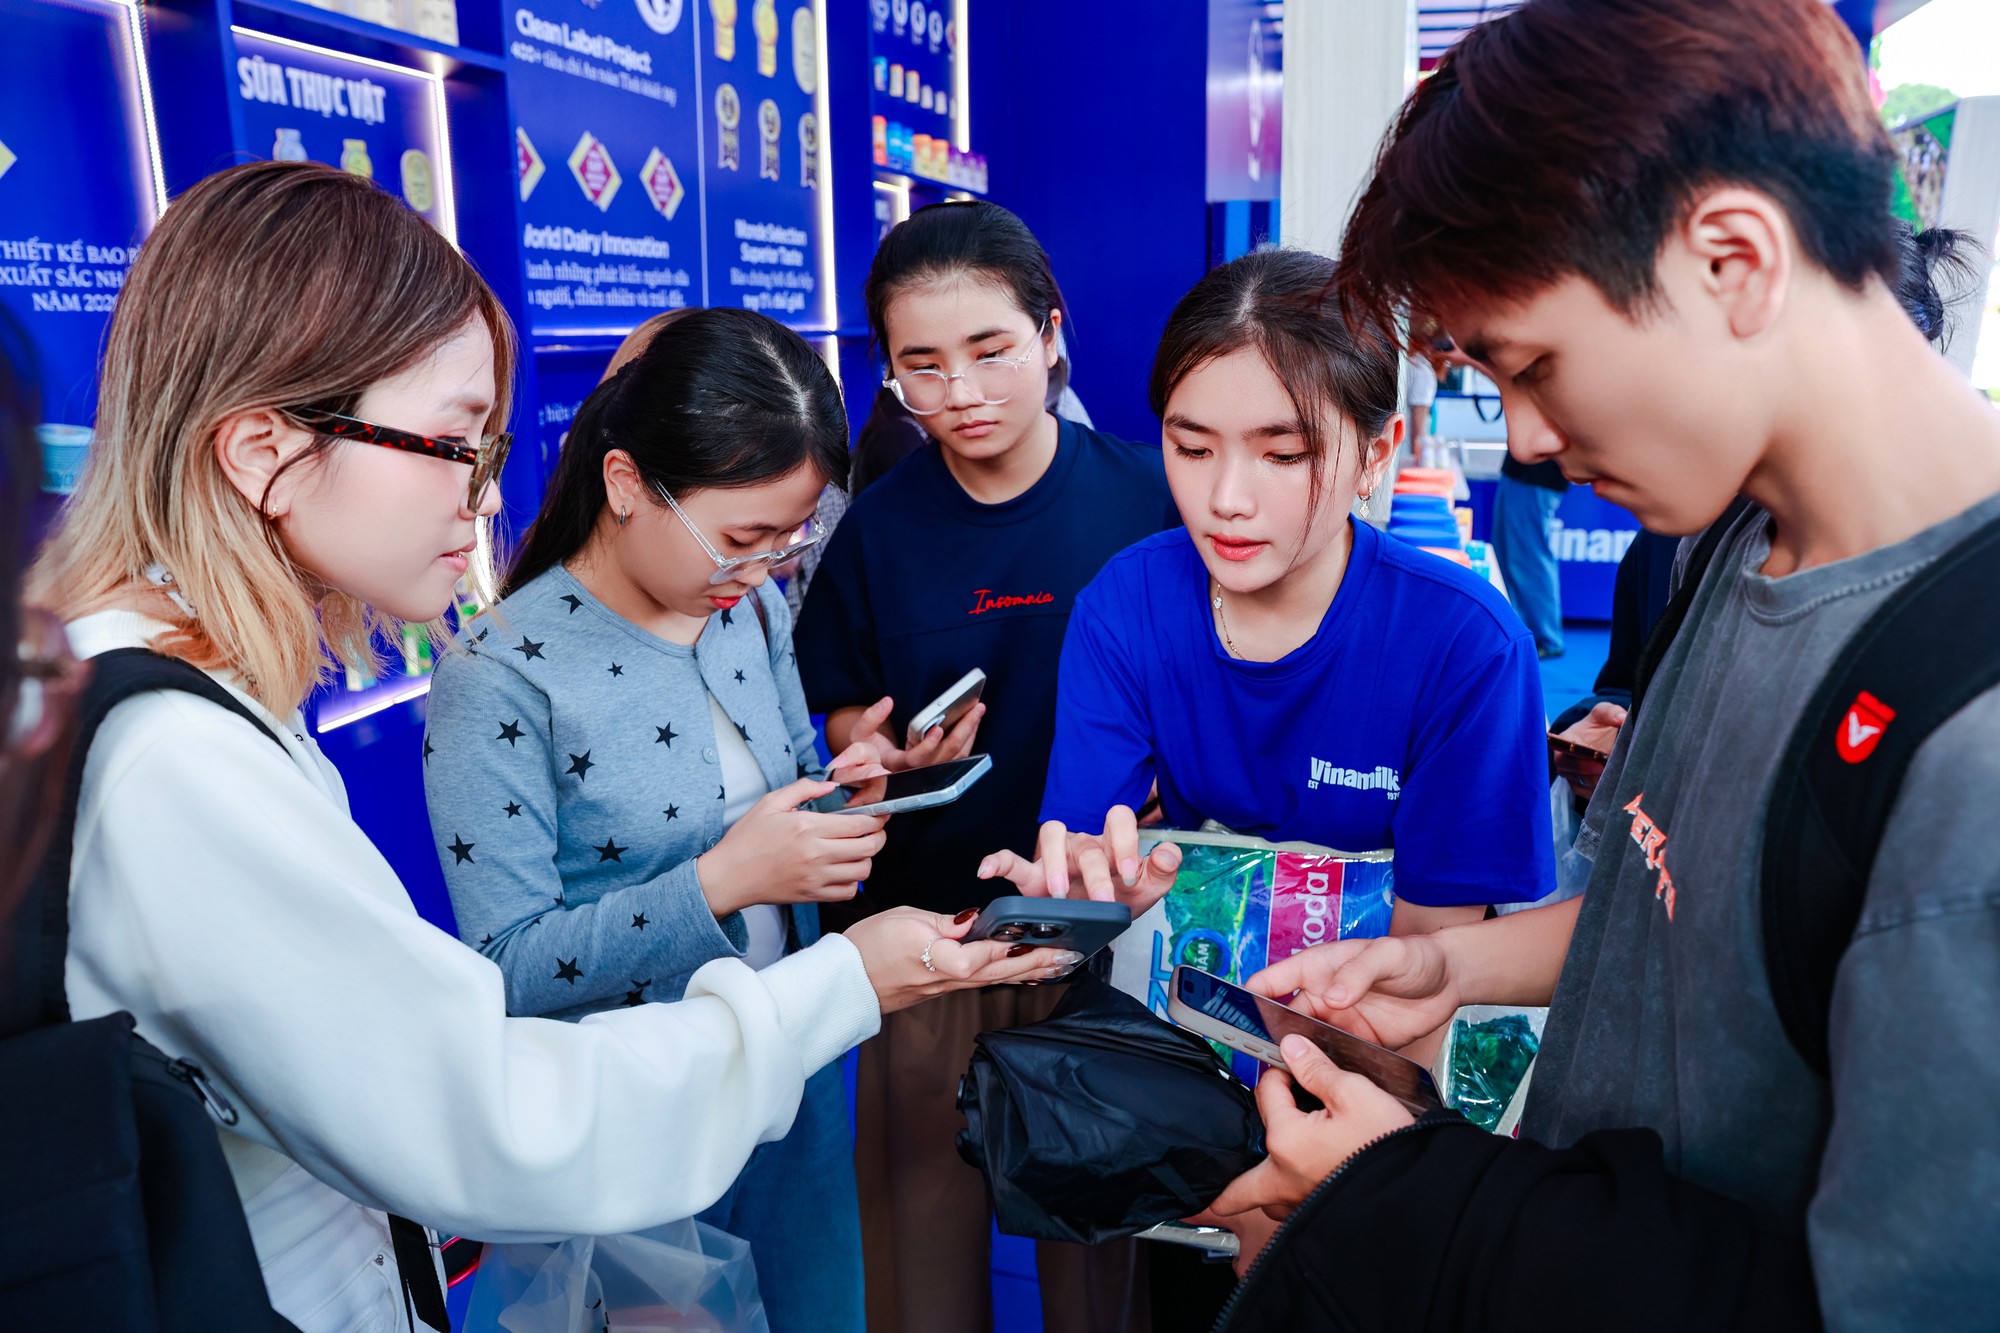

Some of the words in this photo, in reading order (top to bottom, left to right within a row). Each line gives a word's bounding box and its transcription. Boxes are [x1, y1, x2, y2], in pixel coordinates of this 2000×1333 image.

[56, 238, 85, 263] KẾ
[562, 226, 600, 257] Dairy
[601, 230, 670, 260] Innovation
[95, 269, 125, 288] NH
[968, 588, 1055, 615] Insomnia
[1310, 756, 1401, 791] Vinamilk
